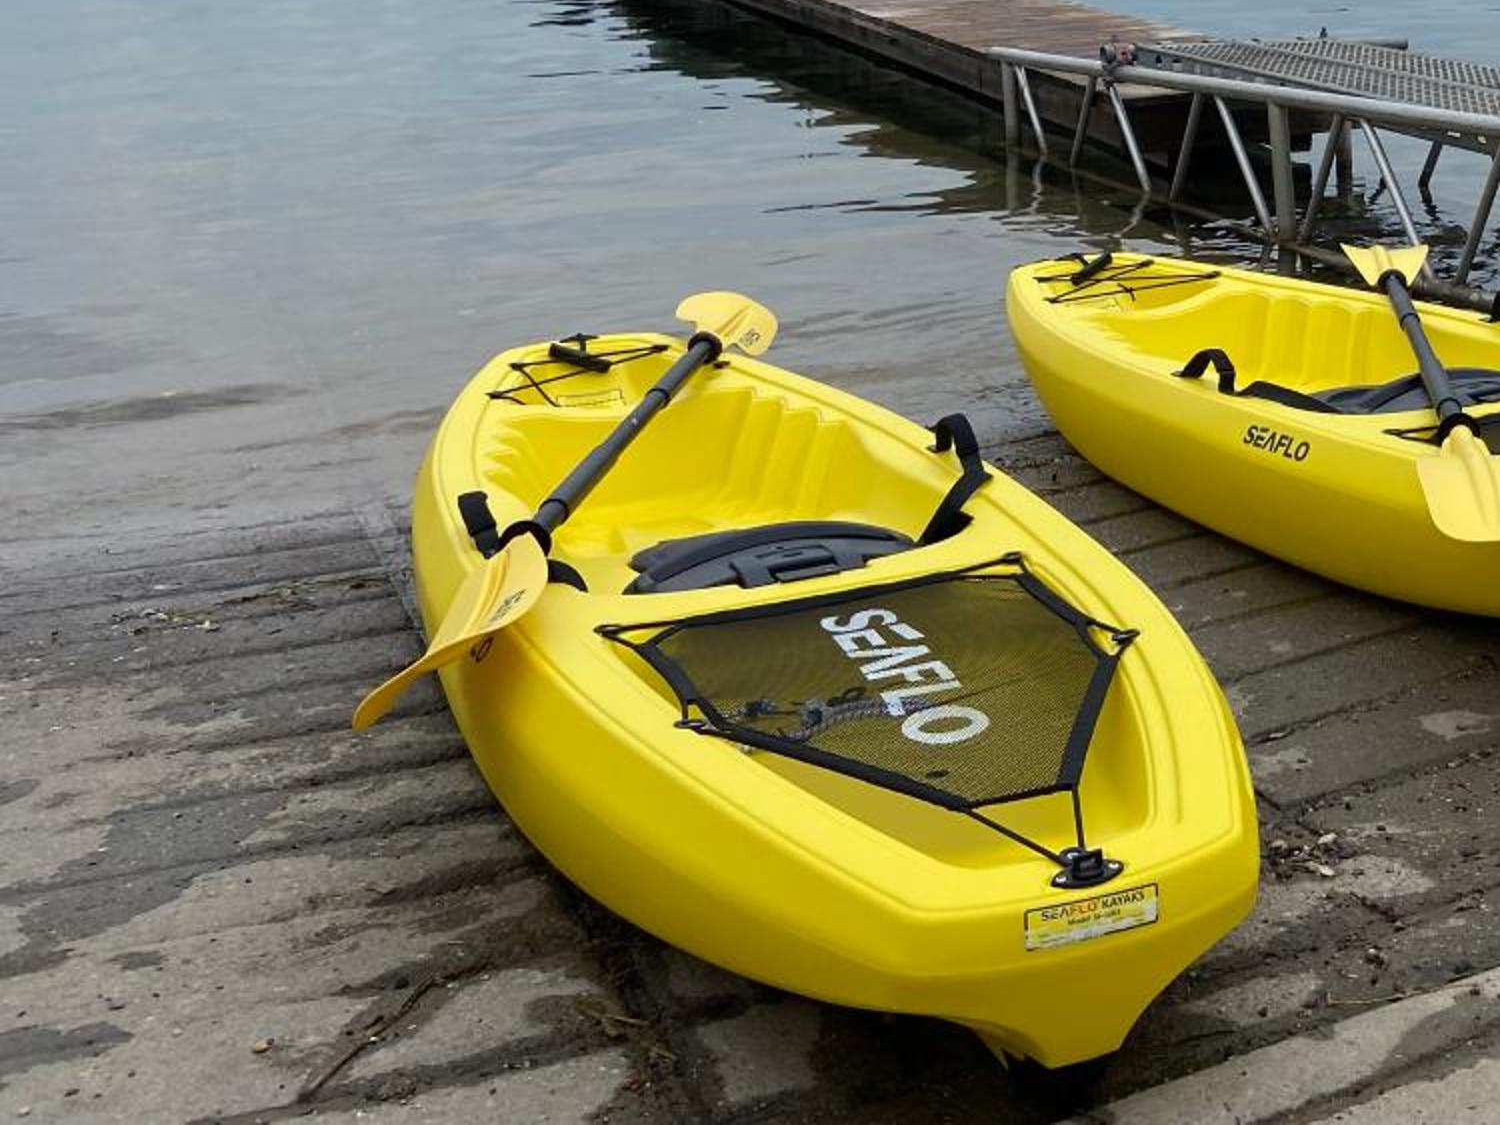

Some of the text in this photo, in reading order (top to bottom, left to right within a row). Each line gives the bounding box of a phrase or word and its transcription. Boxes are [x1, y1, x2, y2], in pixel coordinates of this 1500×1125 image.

[1243, 425, 1310, 461] SEAFLO
[820, 609, 991, 745] SEAFLO
[1041, 901, 1097, 921] SEAFLO
[1101, 891, 1145, 909] KAYAKS
